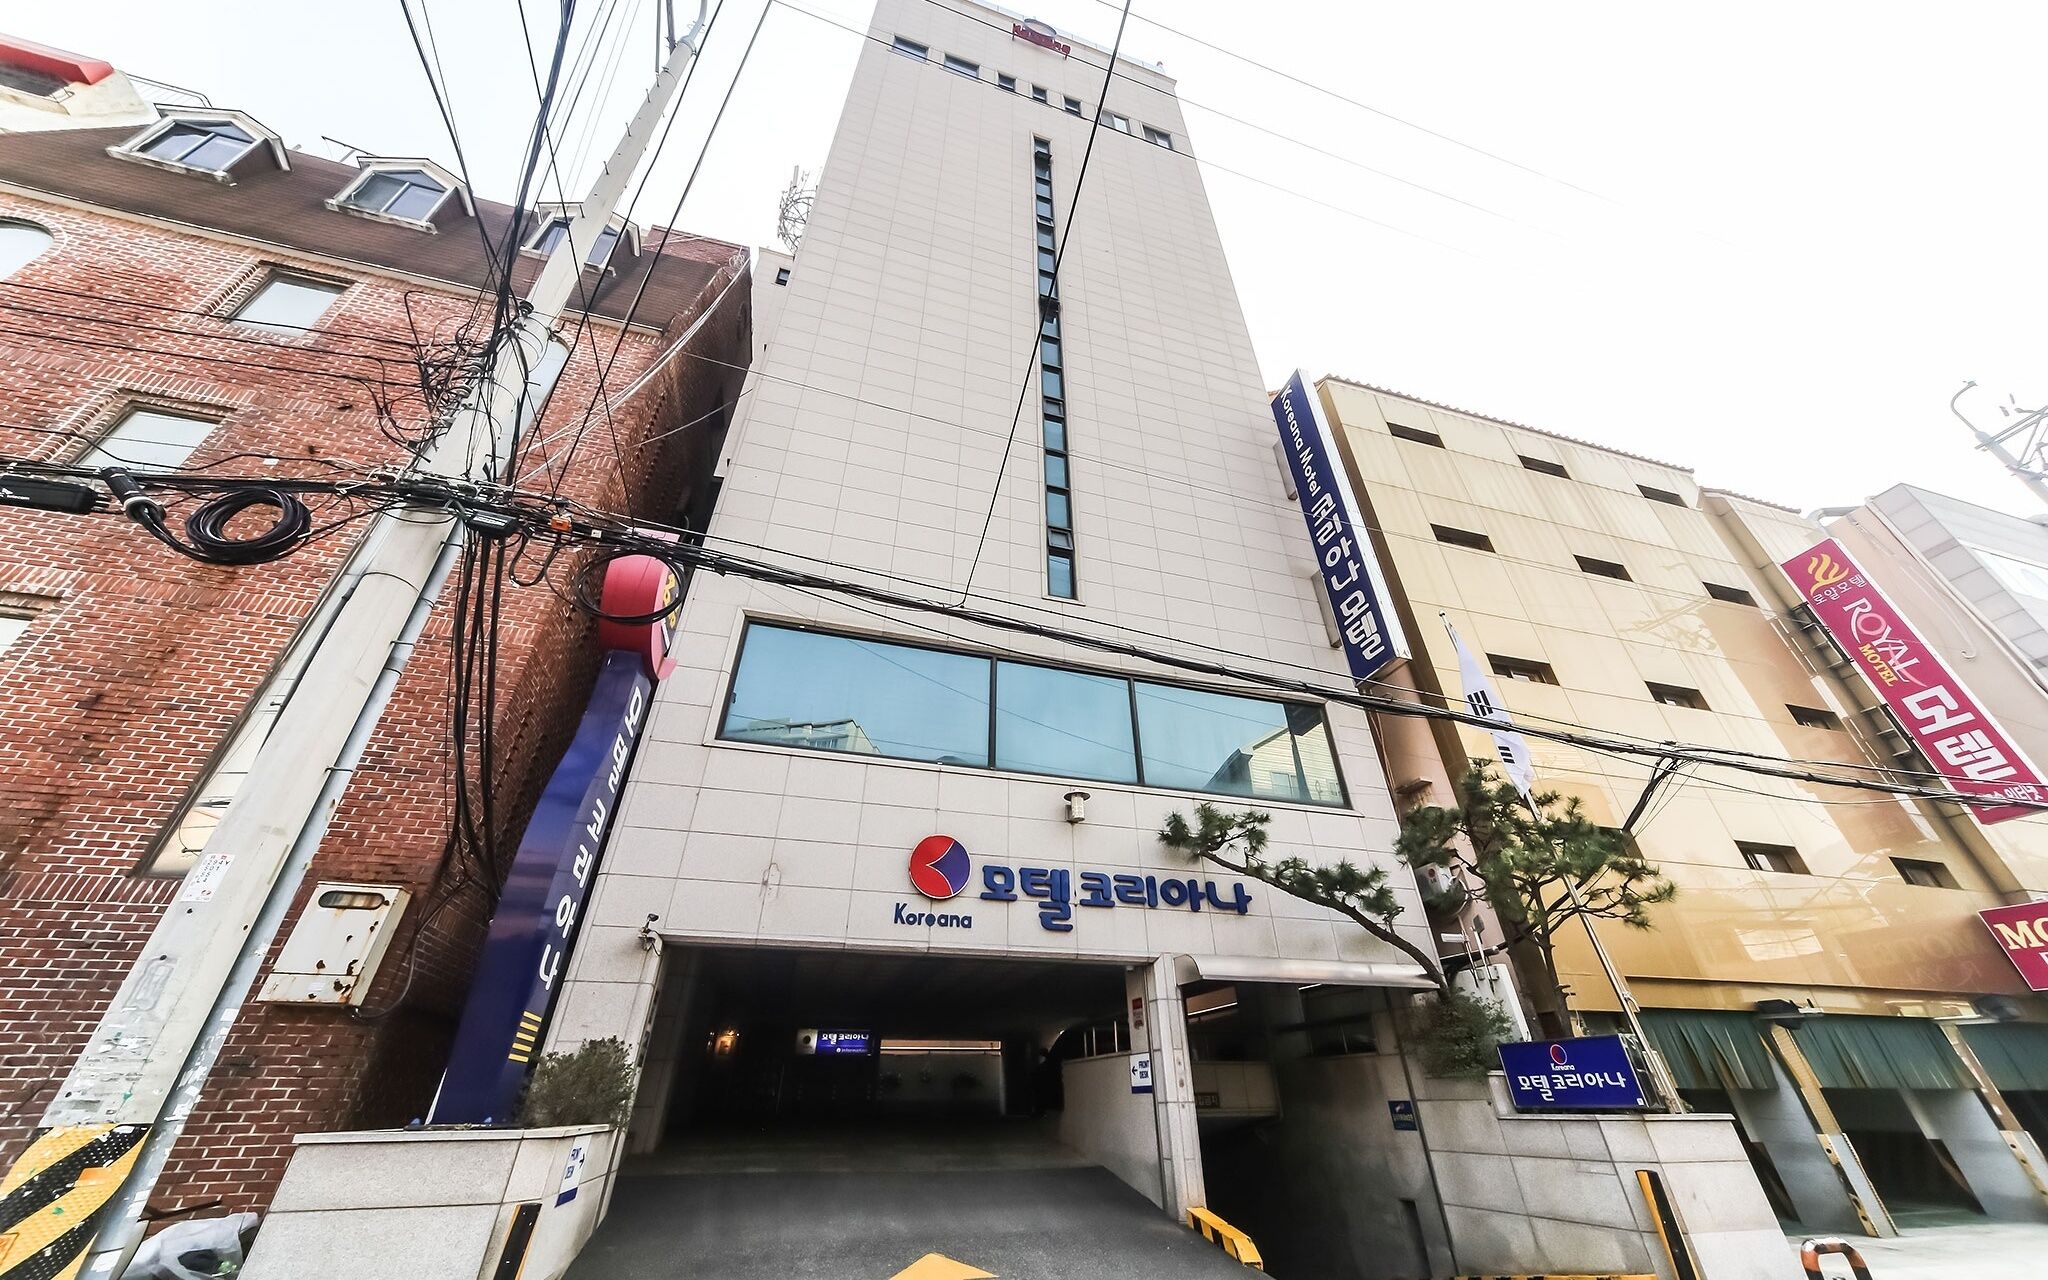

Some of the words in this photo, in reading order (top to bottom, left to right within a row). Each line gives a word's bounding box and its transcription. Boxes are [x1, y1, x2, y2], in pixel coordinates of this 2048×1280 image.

[1280, 384, 1302, 451] Koreana
[1299, 447, 1322, 497] Motel
[1842, 597, 1927, 688] ROYAL
[1857, 643, 1899, 687] MOTEL
[894, 902, 972, 929] Koreana
[1550, 1063, 1576, 1071] Koreana
